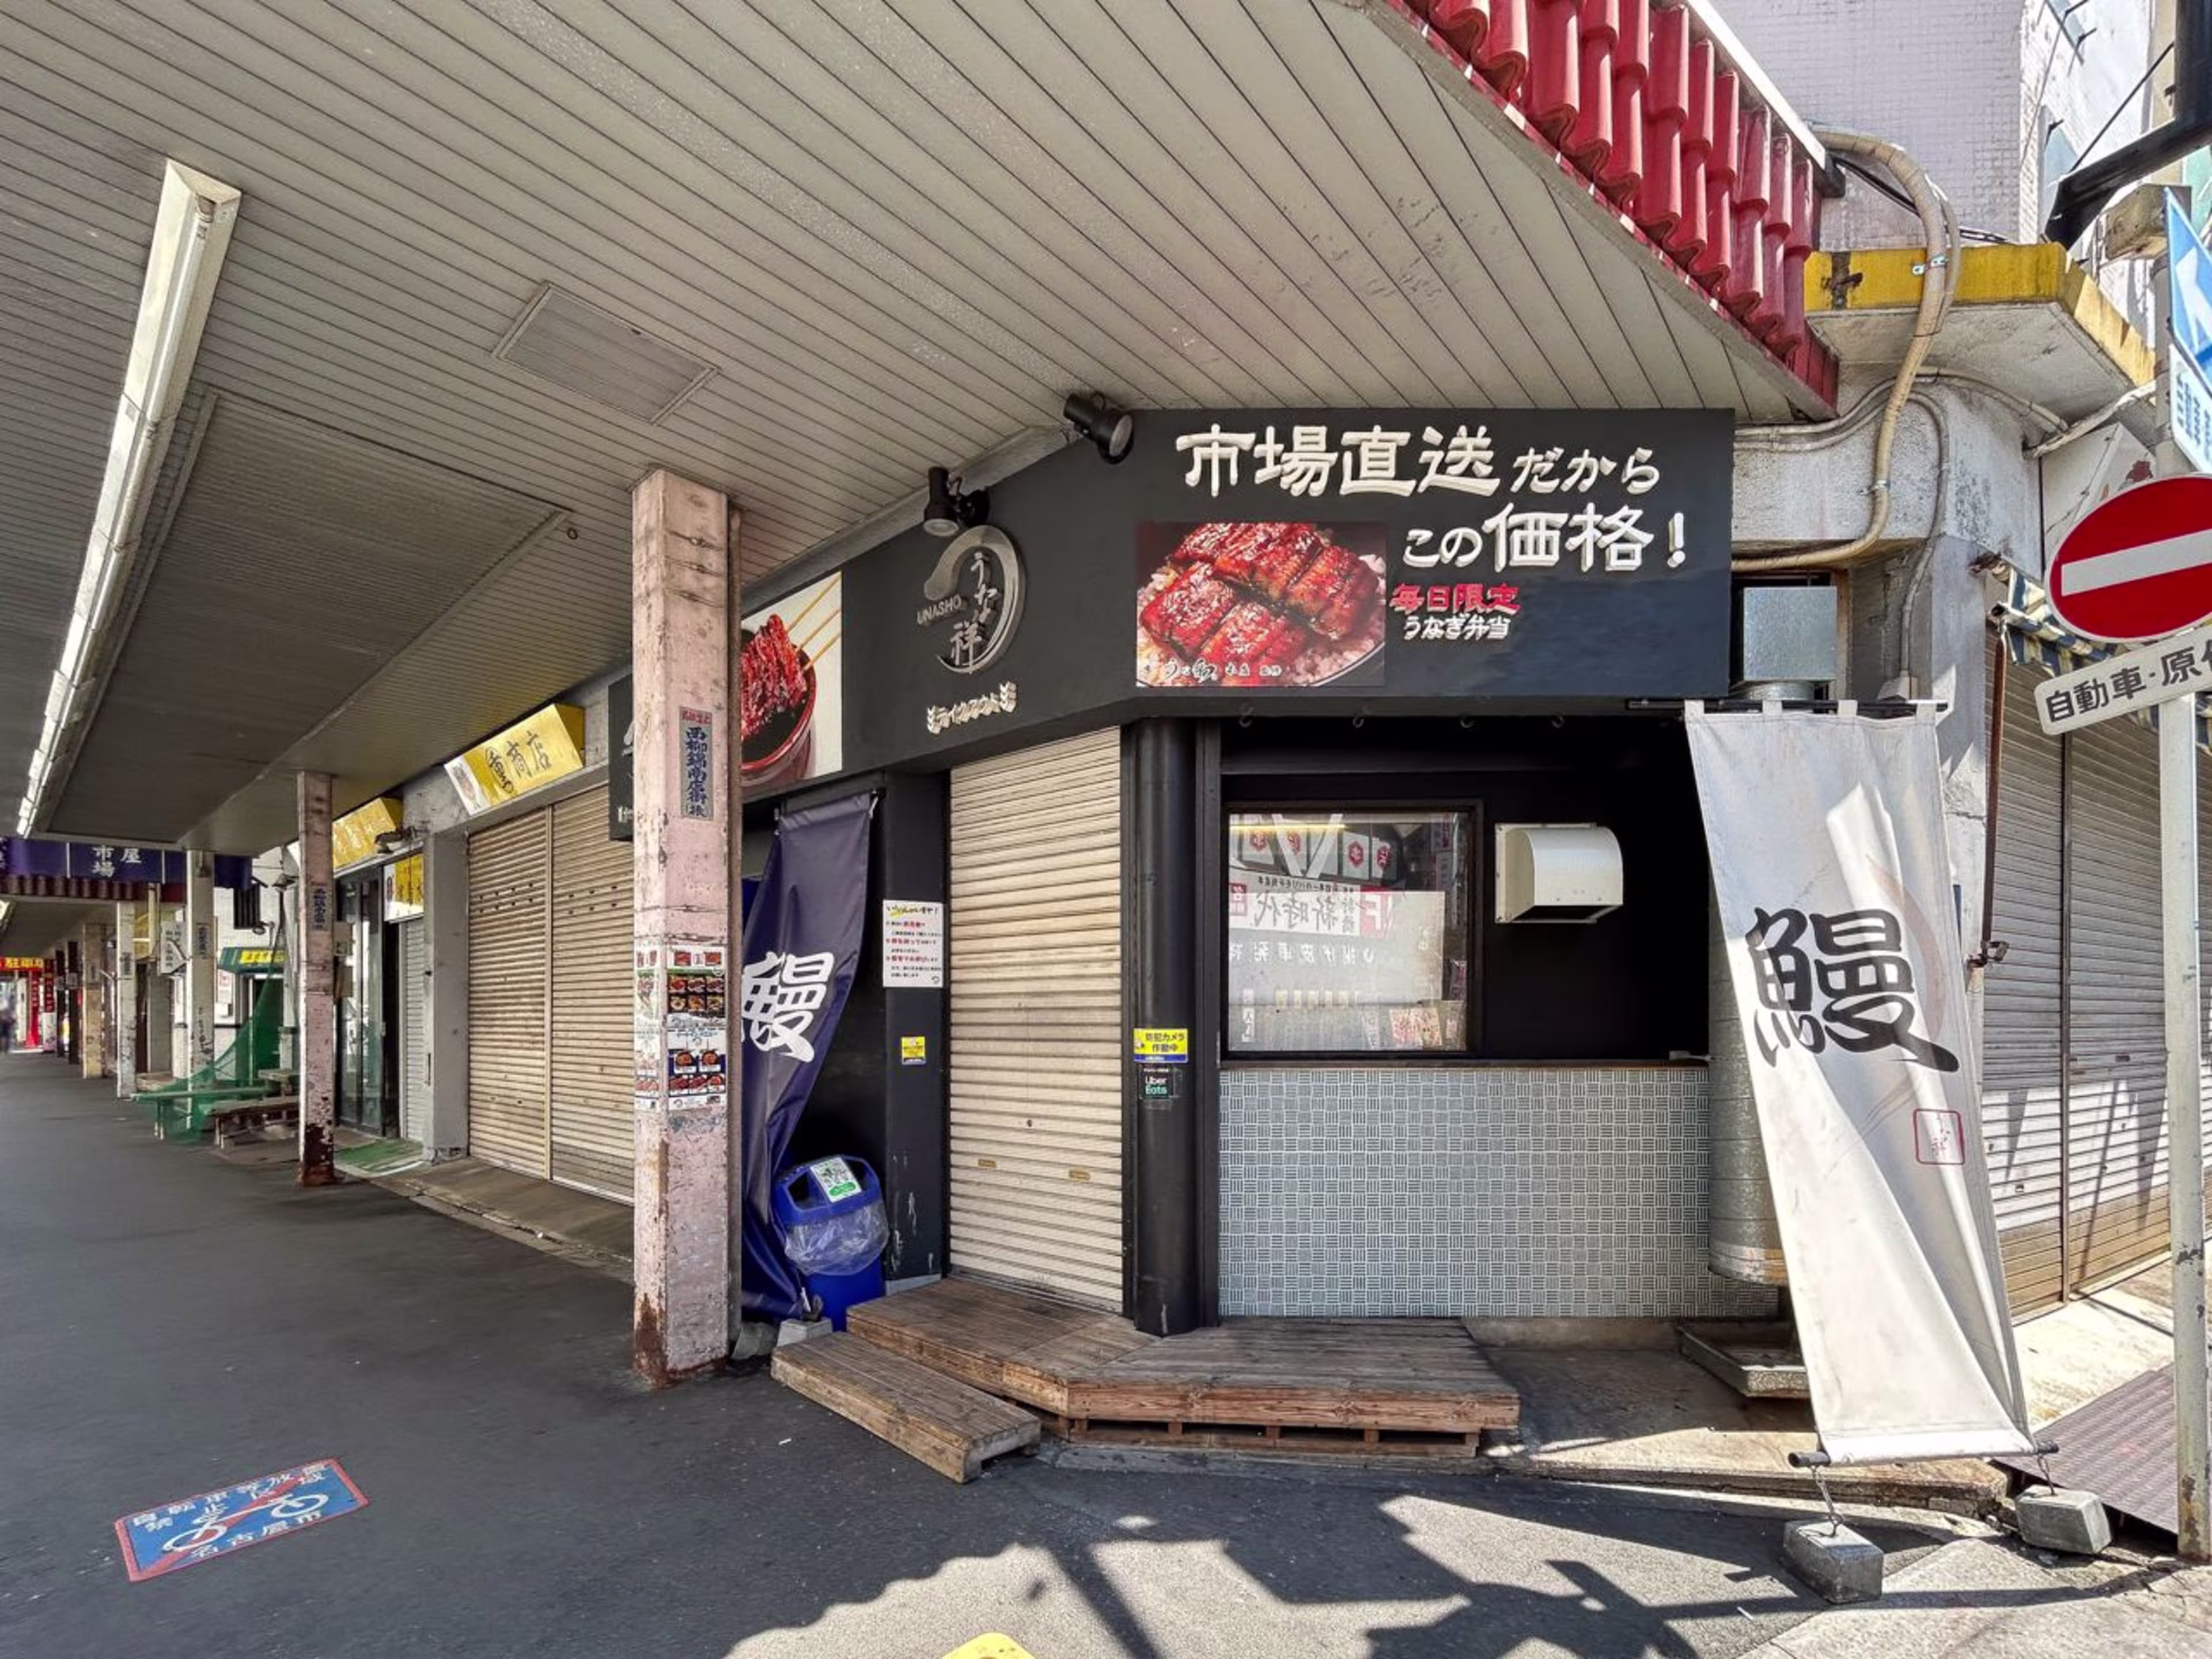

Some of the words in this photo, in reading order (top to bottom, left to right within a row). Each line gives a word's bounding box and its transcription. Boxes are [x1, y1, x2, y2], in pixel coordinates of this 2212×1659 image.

[1402, 501, 1685, 573] この価格!
[916, 594, 963, 625] UNASHO
[1389, 582, 1521, 614] 毎日限定
[1403, 615, 1511, 641] うなぎ弁当
[92, 844, 115, 877] 市場
[1746, 907, 1960, 1074] 鰻
[741, 951, 834, 1063] 鰻
[1145, 1075, 1168, 1084] Uber
[1145, 1084, 1168, 1094] Eats
